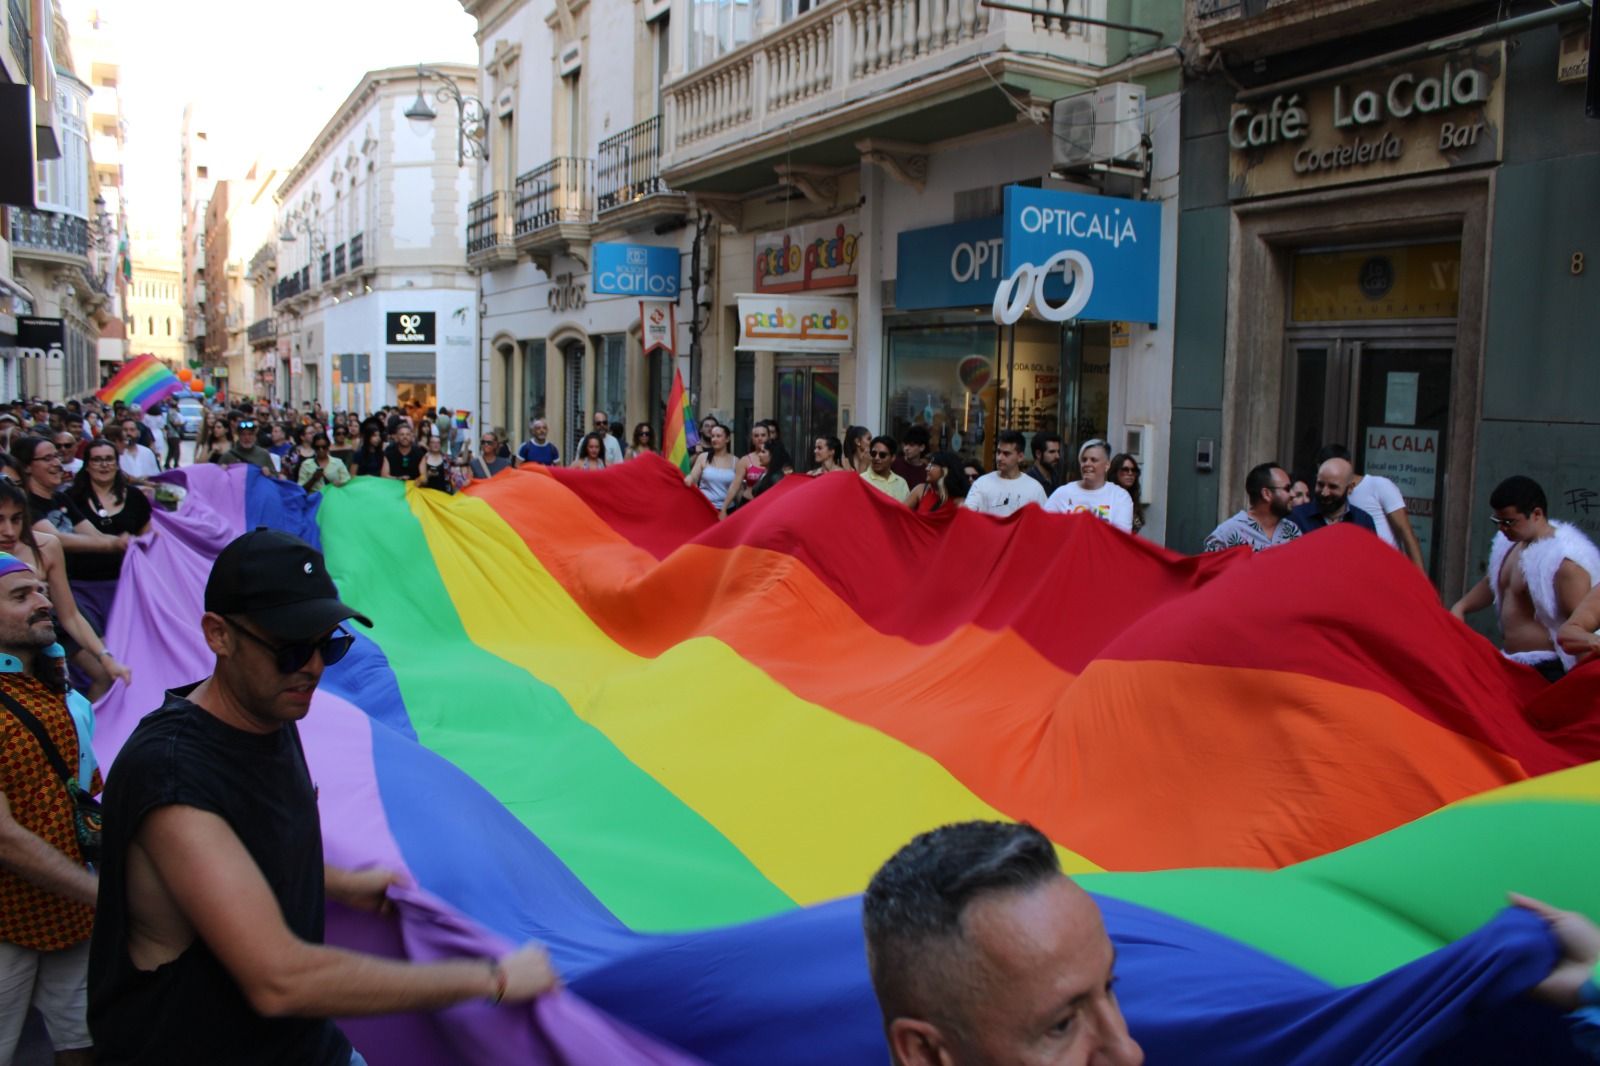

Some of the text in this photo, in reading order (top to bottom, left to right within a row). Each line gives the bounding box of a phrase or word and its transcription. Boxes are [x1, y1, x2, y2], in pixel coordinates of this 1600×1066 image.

[1229, 62, 1486, 149] Café La Cala
[1293, 121, 1484, 172] Coctelería Bar
[1571, 252, 1584, 274] 8
[599, 266, 676, 293] carlos
[1369, 433, 1434, 453] LA CALA
[1367, 461, 1386, 470] Local
[1405, 463, 1434, 474] Plantas
